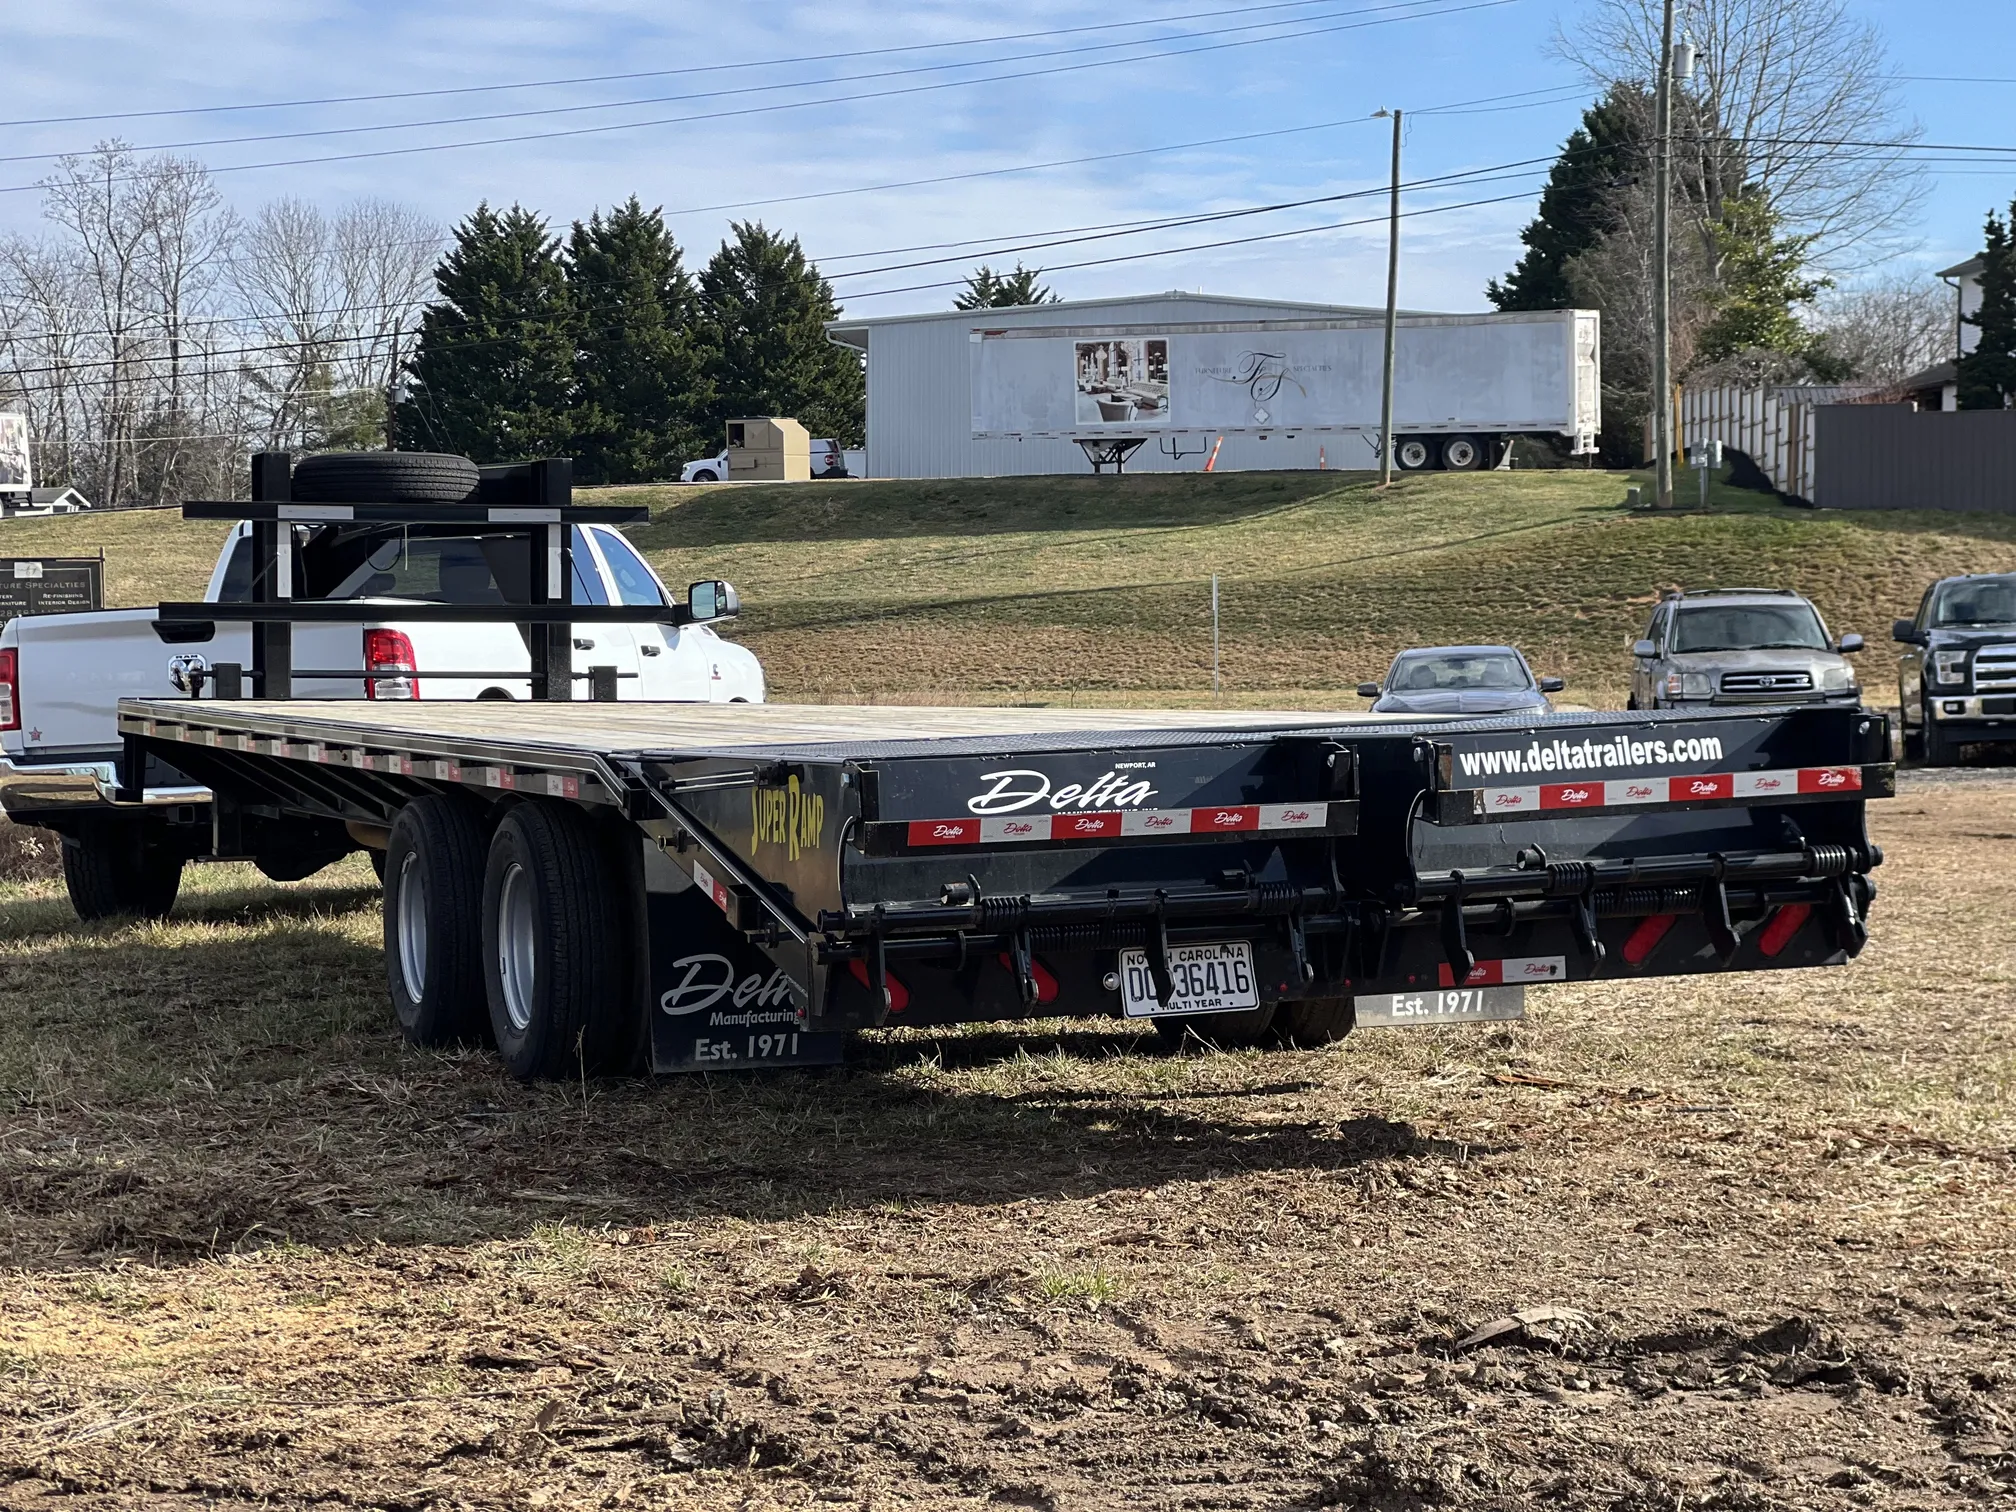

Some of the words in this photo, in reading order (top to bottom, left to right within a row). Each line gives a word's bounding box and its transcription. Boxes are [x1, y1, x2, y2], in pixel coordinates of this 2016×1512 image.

[1459, 735, 1723, 776] www.deltatrailers.com
[968, 769, 1159, 815] Delta
[751, 786, 787, 857] SUPER
[788, 774, 824, 862] RAMP
[932, 825, 964, 837] Delta
[1003, 822, 1033, 834] Delta
[1074, 818, 1105, 830] Delta
[1144, 815, 1173, 827] Delta
[1213, 812, 1243, 824] Delta
[1281, 810, 1309, 821] Delta
[1194, 998, 1222, 1008] YEAR
[1392, 994, 1429, 1017] Est.
[1437, 990, 1484, 1014] 1971
[709, 1008, 801, 1028] Manufacturing
[695, 1037, 738, 1061] Est.
[748, 1033, 799, 1058] 1971
